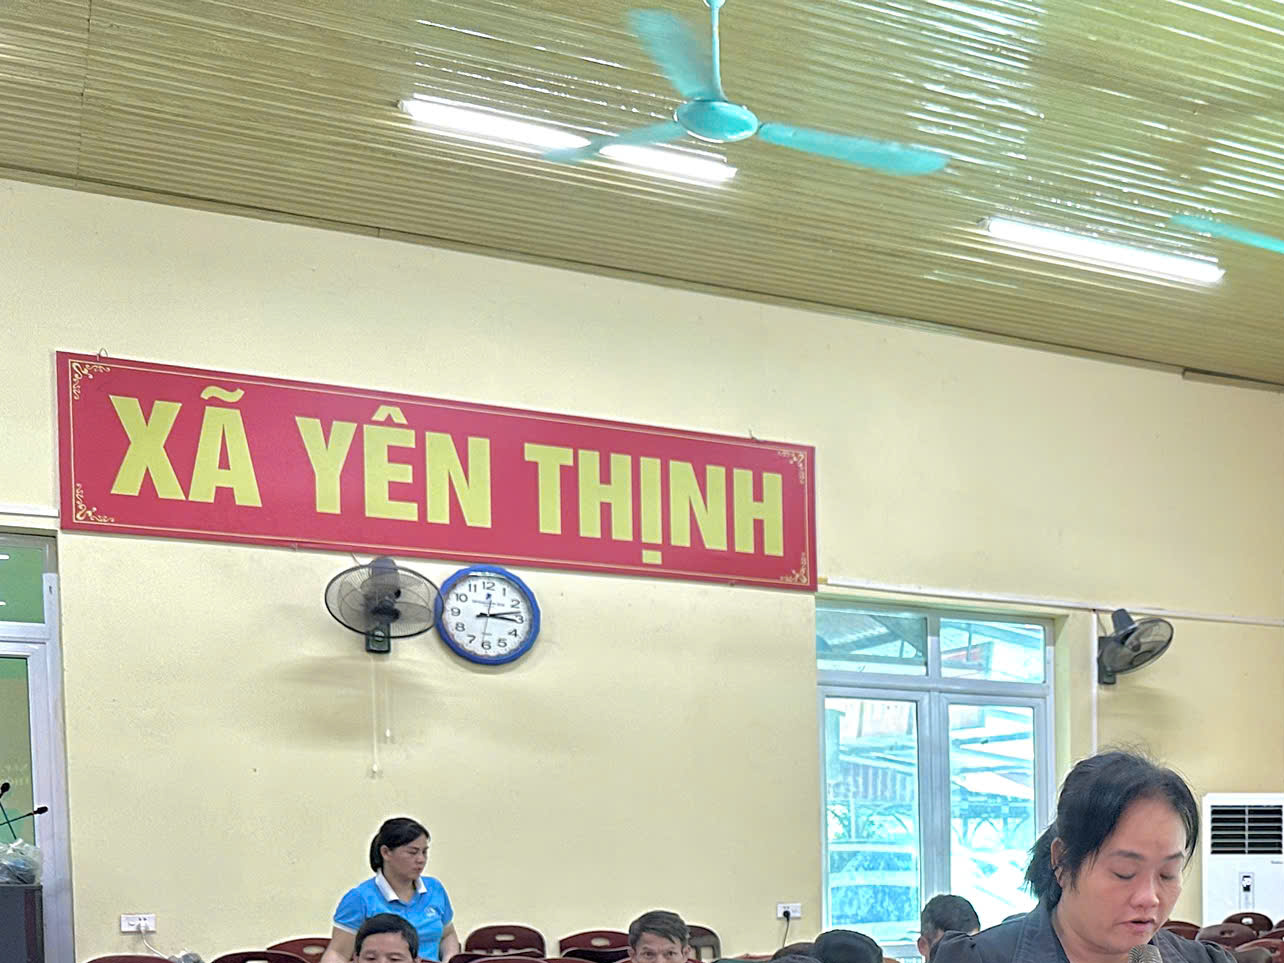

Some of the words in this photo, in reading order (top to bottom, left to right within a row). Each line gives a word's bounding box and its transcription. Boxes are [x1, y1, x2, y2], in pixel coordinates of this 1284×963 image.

[109, 385, 263, 508] XÃ
[295, 405, 493, 529] YÊN
[523, 442, 785, 565] THỊNH
[468, 583, 477, 593] 11
[482, 581, 495, 591] 12
[502, 587, 507, 596] 1
[455, 593, 468, 602] 10
[510, 599, 521, 609] 2
[450, 607, 461, 616] 9
[514, 615, 524, 624] 3
[455, 622, 465, 632] 8
[508, 629, 518, 638] 4
[467, 635, 476, 644] 7
[497, 638, 507, 648] 5
[481, 641, 492, 650] 6
